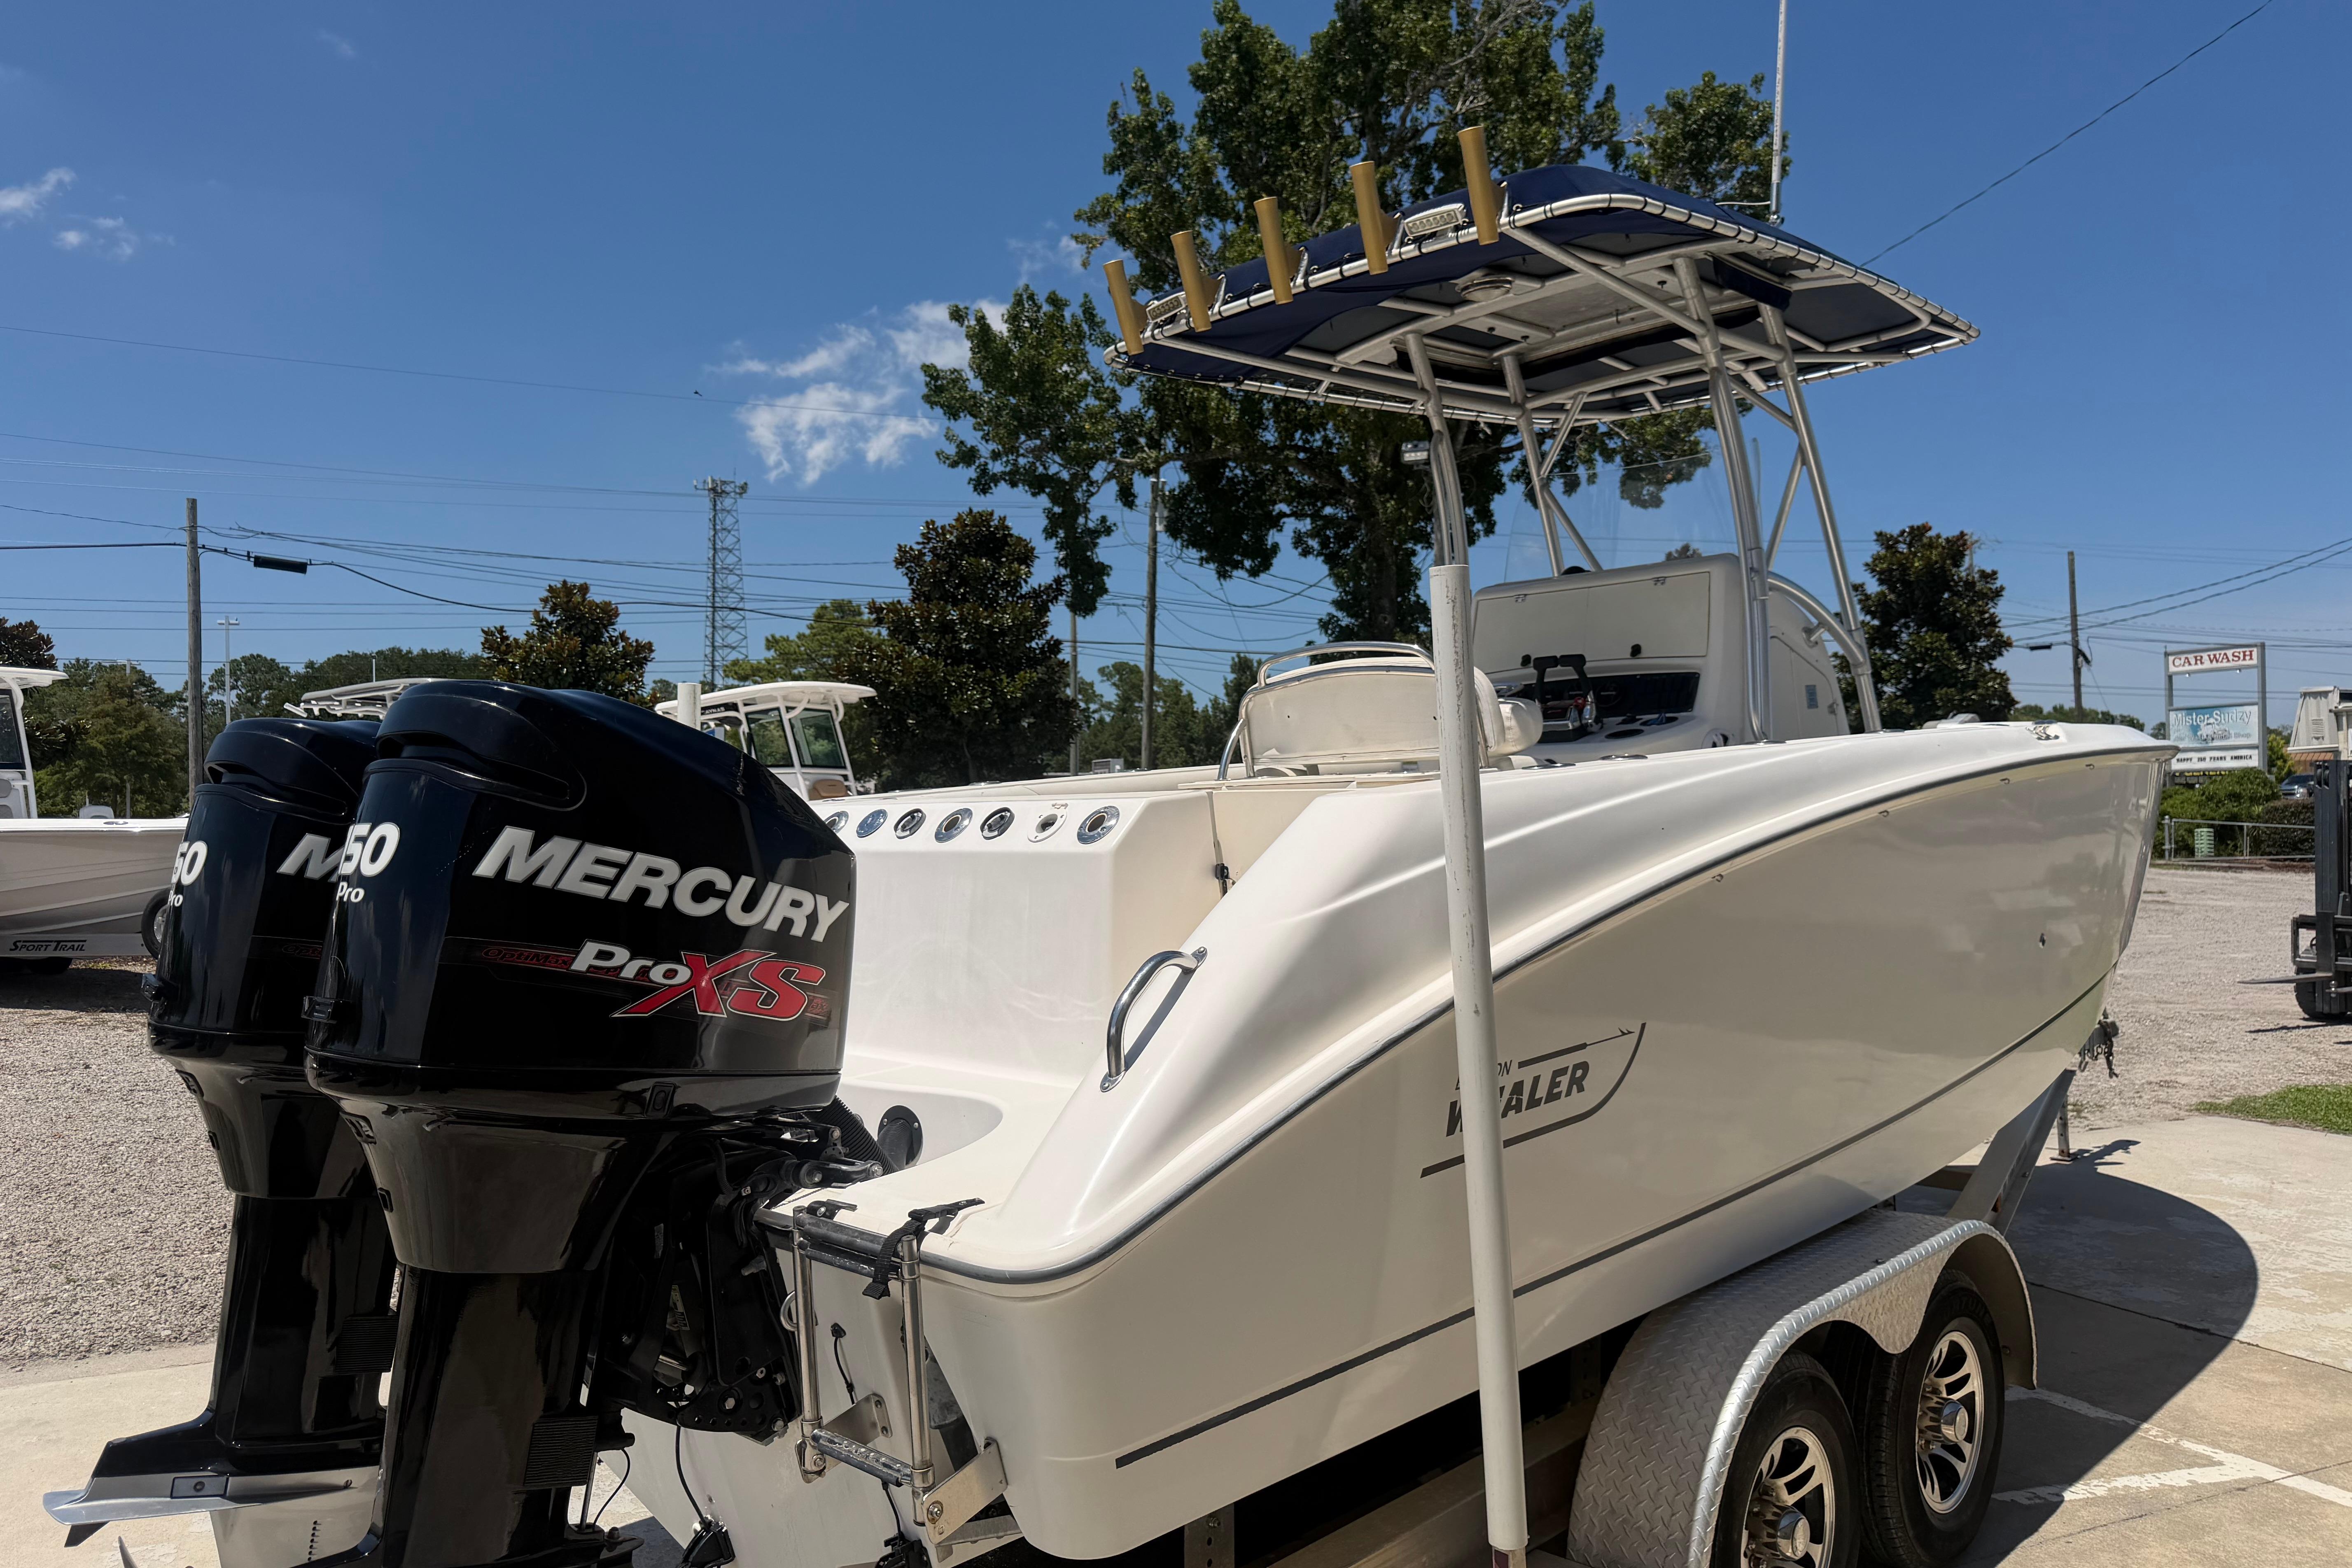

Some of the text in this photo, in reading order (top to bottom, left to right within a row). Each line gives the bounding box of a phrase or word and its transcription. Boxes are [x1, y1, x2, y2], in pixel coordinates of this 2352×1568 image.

[2172, 649, 2254, 668] CAR WASH
[2173, 709, 2252, 726] Mister Sudzy
[337, 822, 400, 877] 50
[171, 840, 208, 886] 50
[336, 881, 365, 903] Pro
[472, 825, 849, 943] MERCURY
[9, 940, 87, 952] SPORT TRAIL
[482, 947, 569, 966] OptiMax
[1446, 1061, 1589, 1137] ALER
